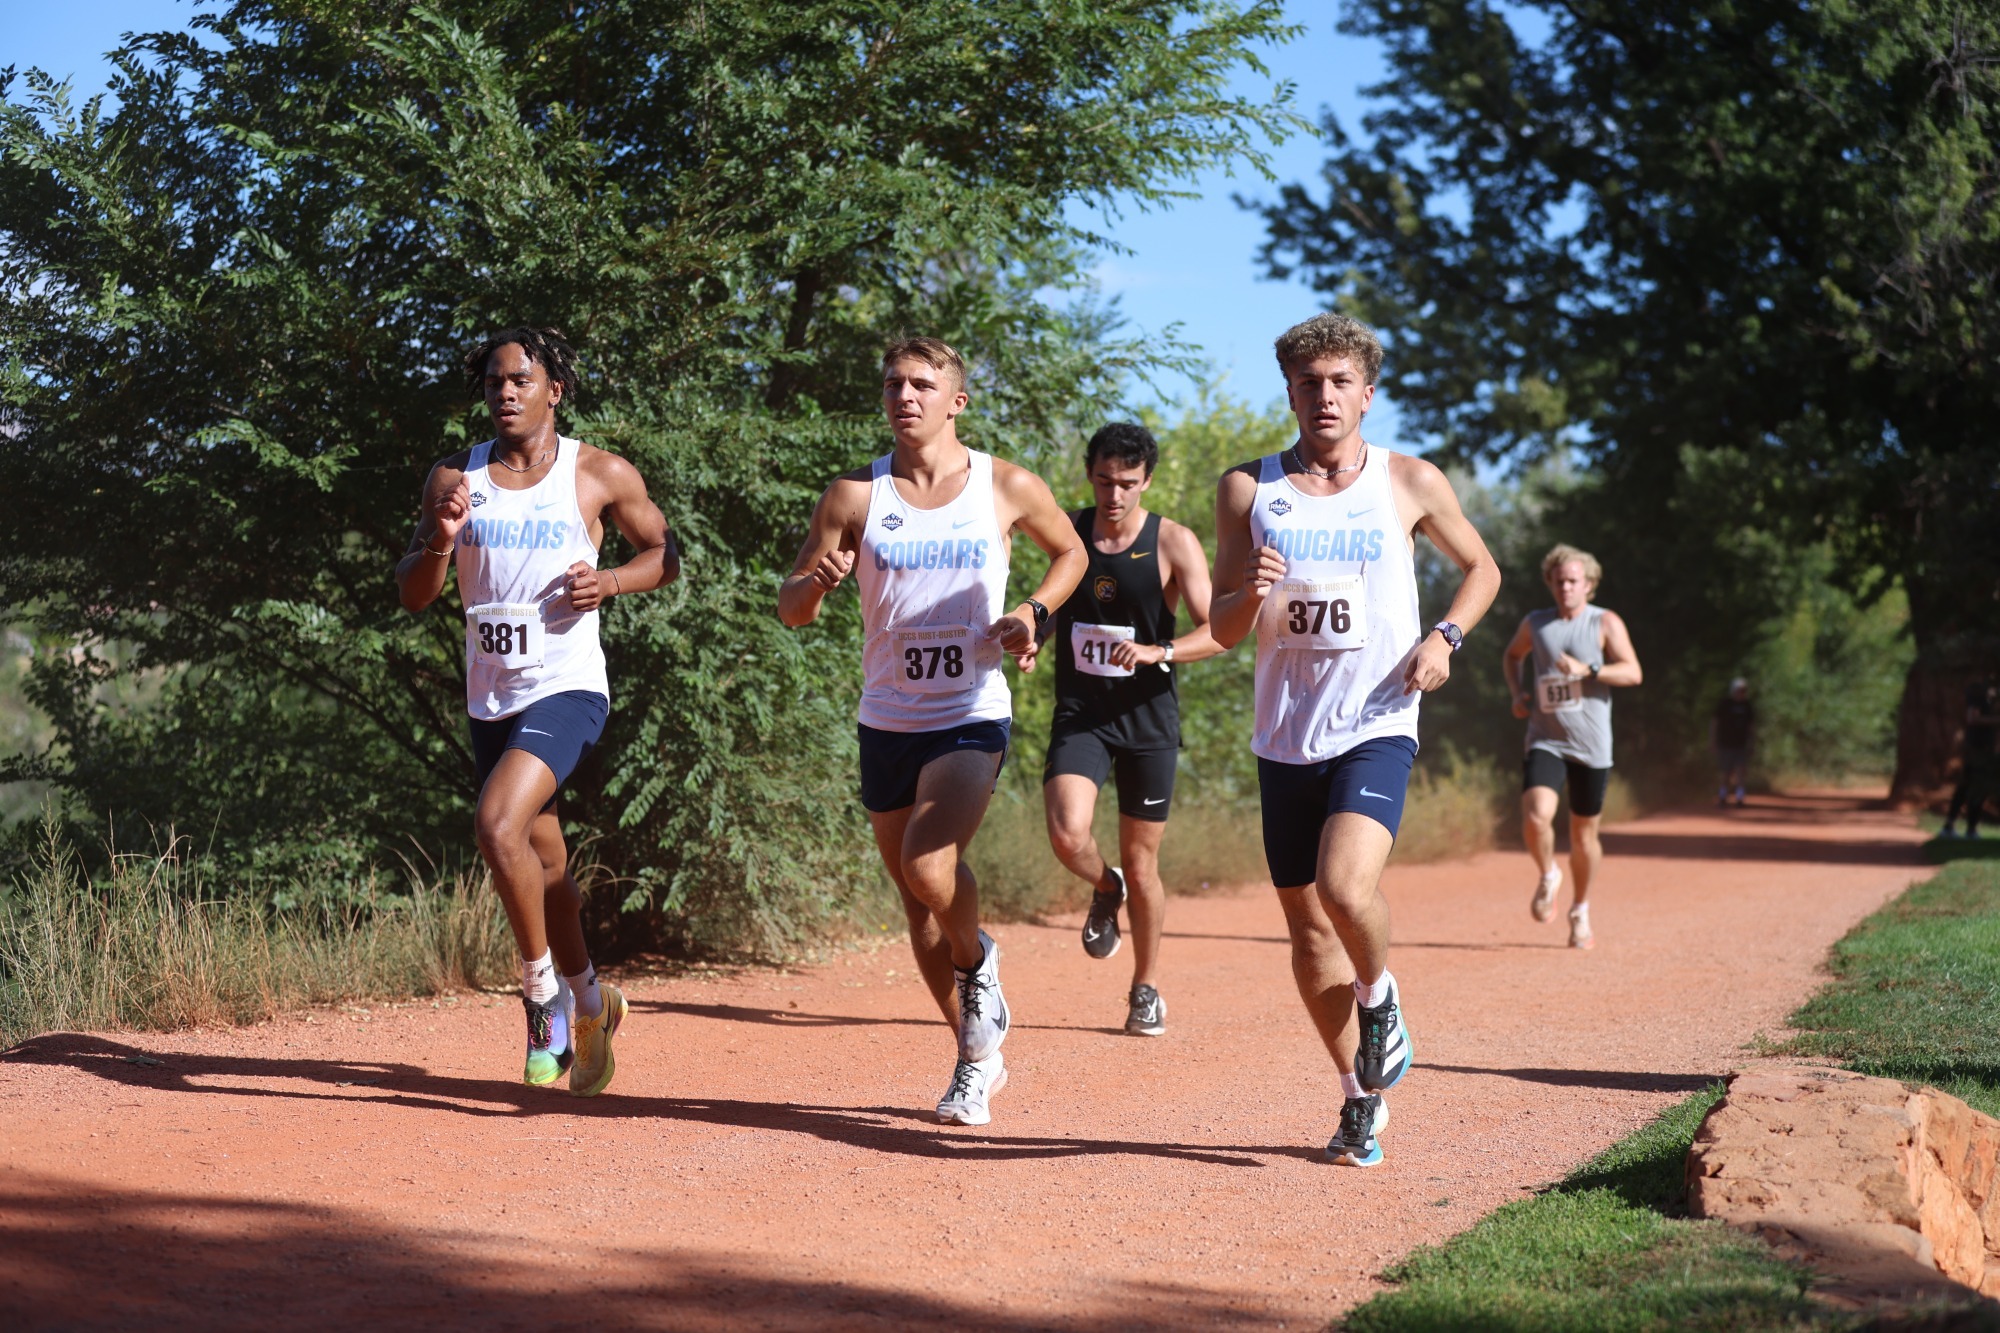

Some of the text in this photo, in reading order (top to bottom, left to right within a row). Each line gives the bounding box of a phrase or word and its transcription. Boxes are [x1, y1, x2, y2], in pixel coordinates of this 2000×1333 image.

[1270, 503, 1292, 511] RMAC
[461, 518, 567, 550] COUGARS
[882, 519, 903, 527] RMAC
[874, 538, 989, 572] COUGARS
[1282, 581, 1354, 594] UCCS RUST-BUSTER
[491, 607, 538, 617] RUST-BUSTER
[1287, 598, 1351, 635] 376
[478, 622, 527, 655] 381
[898, 629, 967, 641] UCCS RUST-BUSTER
[904, 644, 964, 681] 378
